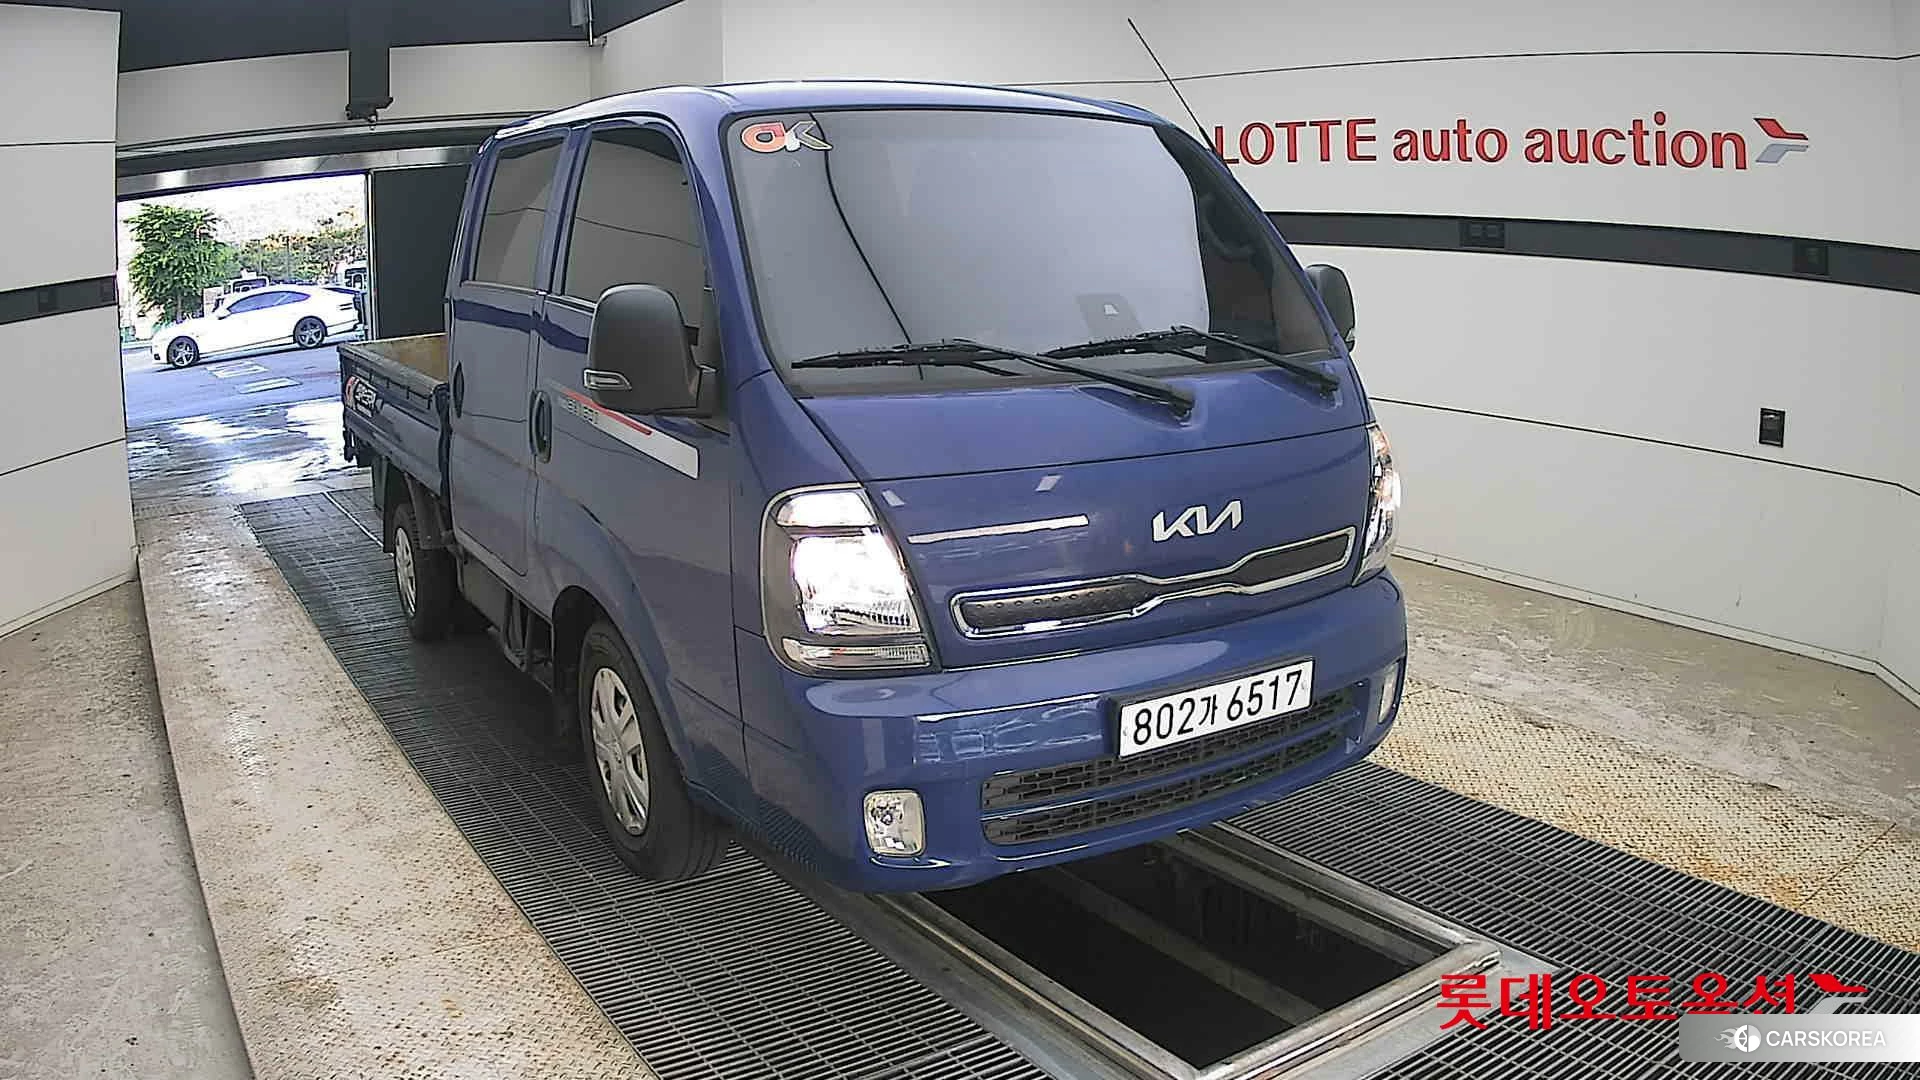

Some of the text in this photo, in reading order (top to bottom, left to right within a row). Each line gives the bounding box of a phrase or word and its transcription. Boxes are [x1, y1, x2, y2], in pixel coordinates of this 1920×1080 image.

[741, 120, 834, 153] OK
[1214, 112, 1746, 170] LOTTE auto auction
[1152, 500, 1243, 542] KIA
[1133, 670, 1303, 746] 802가 6517
